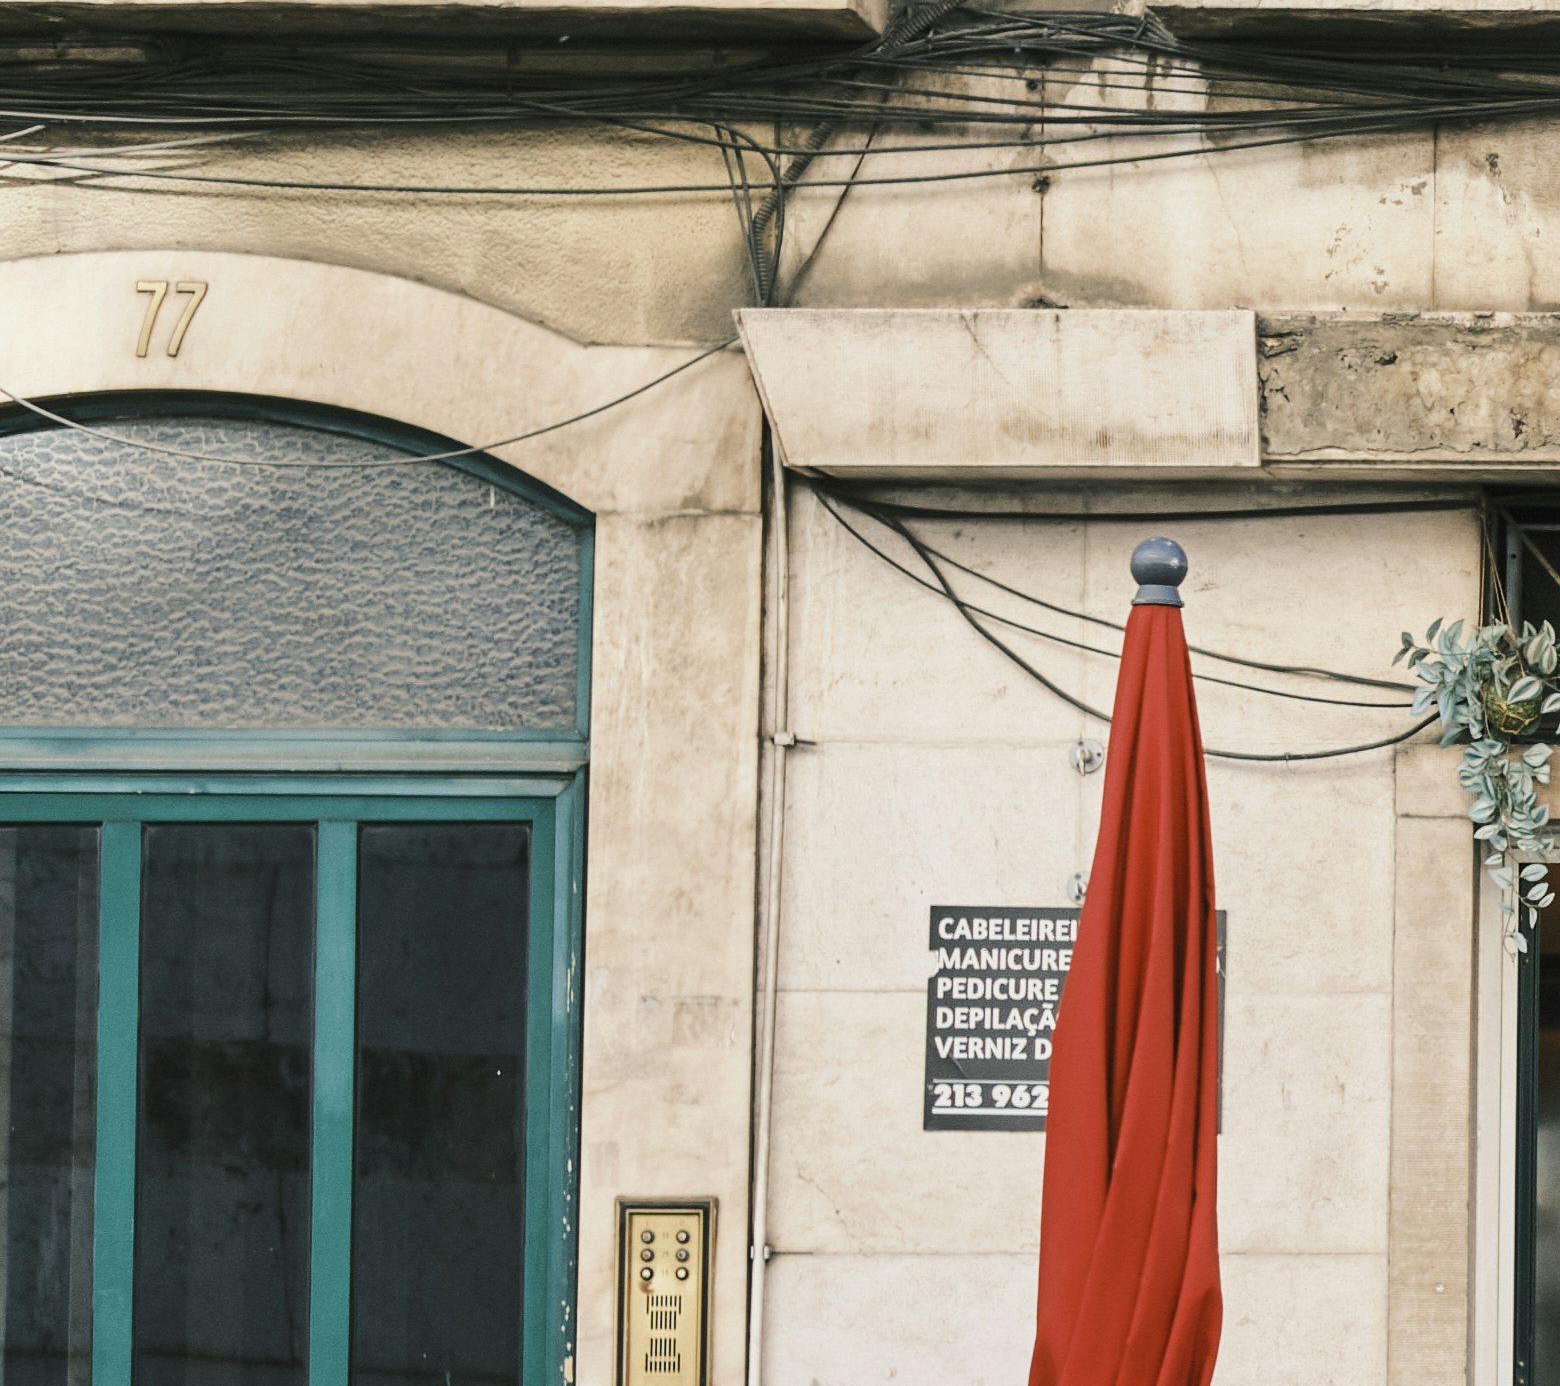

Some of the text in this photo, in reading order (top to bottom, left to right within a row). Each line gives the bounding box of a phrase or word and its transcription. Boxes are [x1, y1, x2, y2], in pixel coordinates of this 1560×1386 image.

[136, 280, 208, 358] 77
[938, 918, 1081, 941] CABELEIREI
[938, 948, 1071, 971] MANICURE
[937, 978, 1059, 1000] PEDICURE
[936, 1004, 1057, 1036] DEPILAÇÃ
[936, 1038, 1053, 1061] VERNIZ D
[934, 1084, 1049, 1109] 213 962
